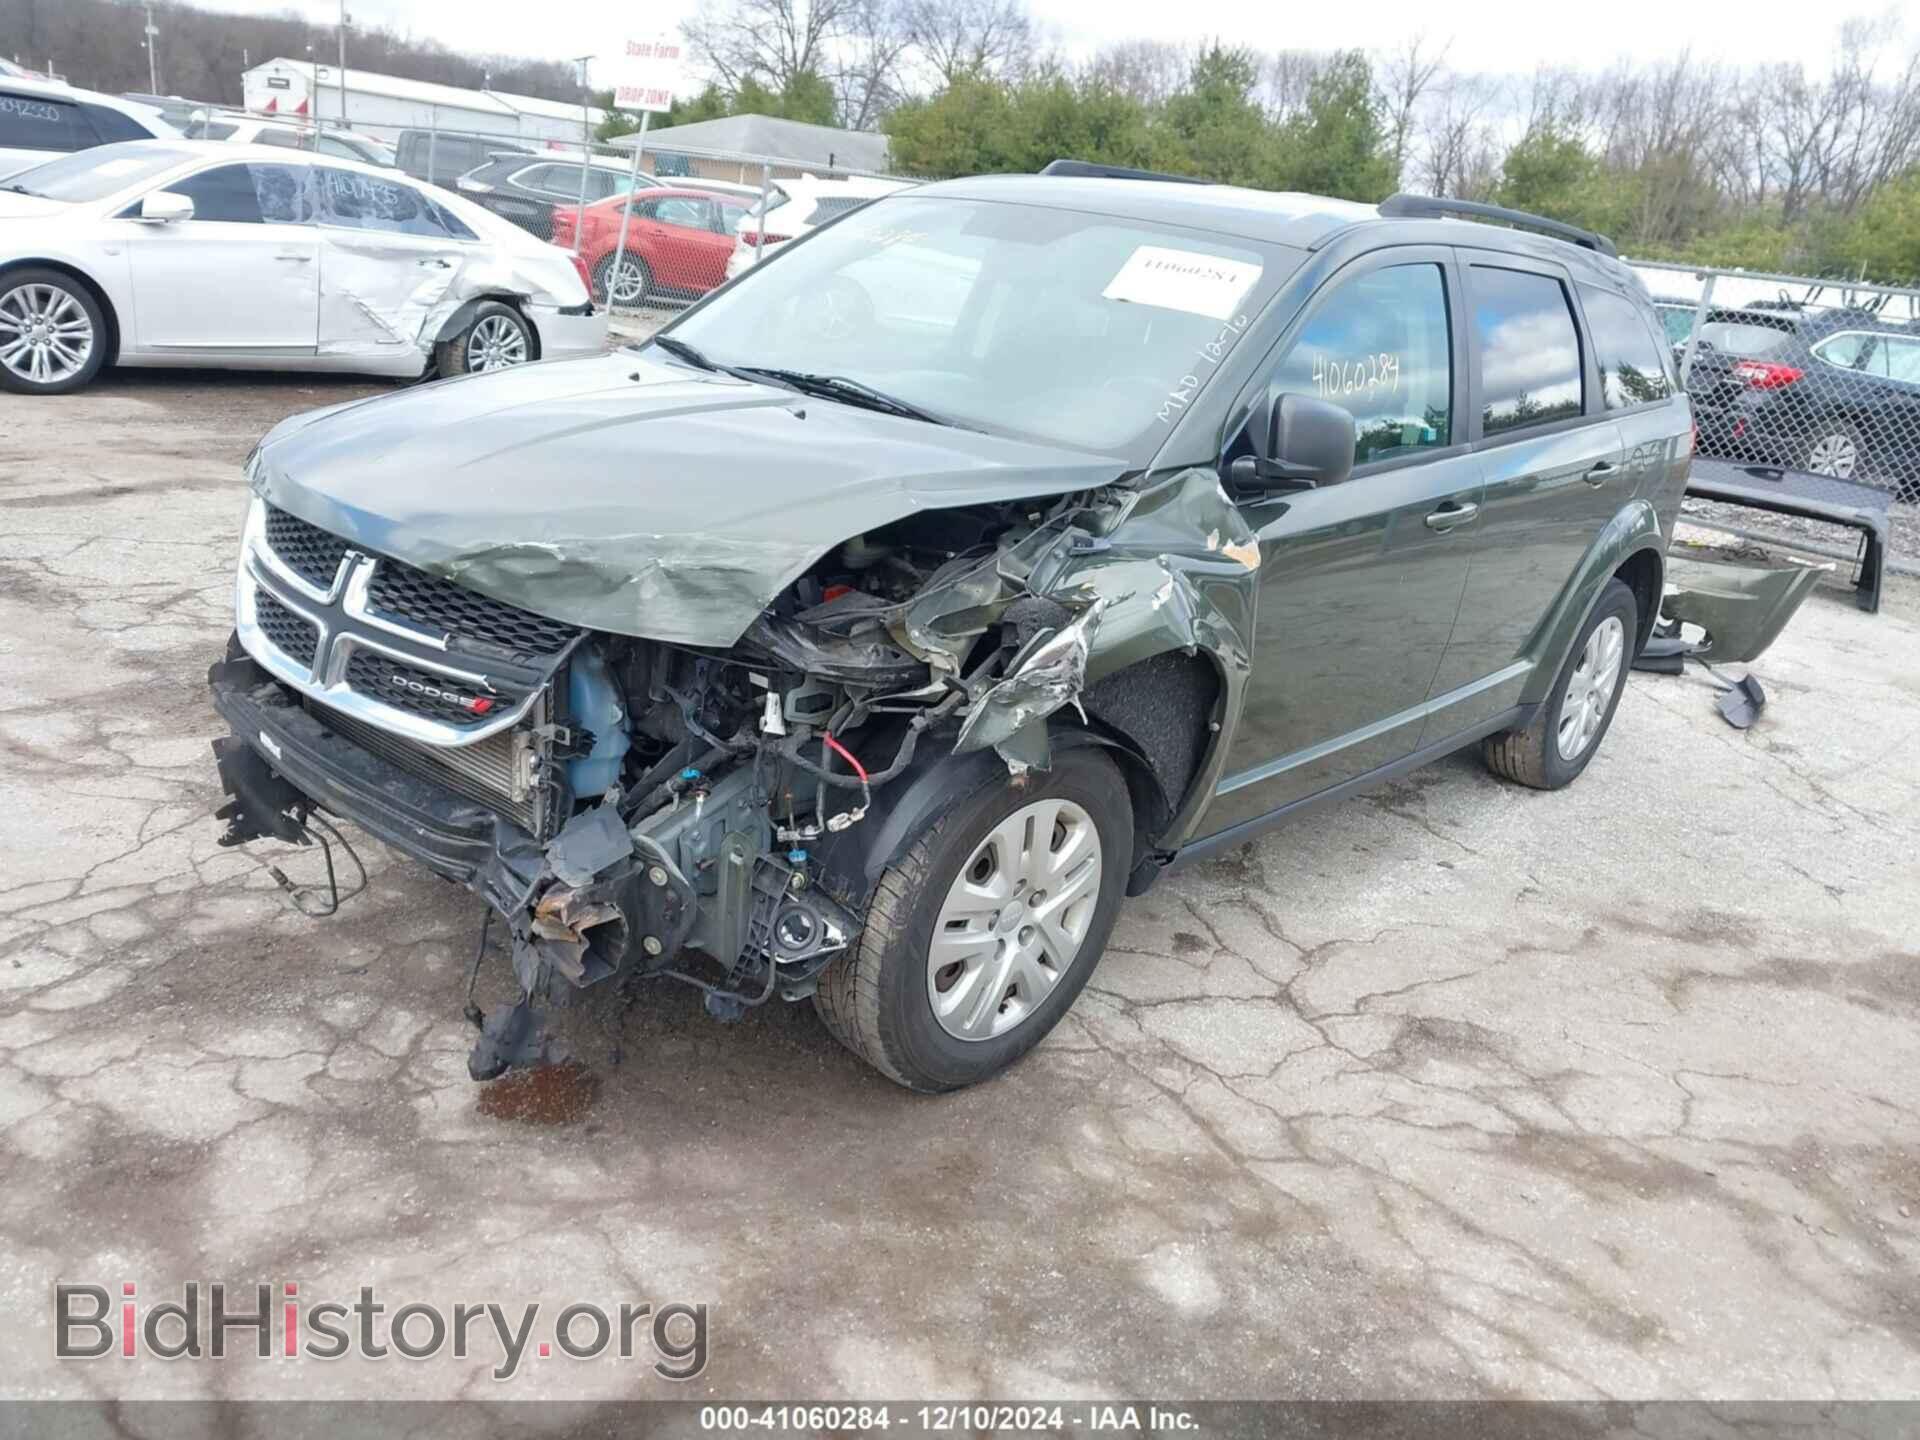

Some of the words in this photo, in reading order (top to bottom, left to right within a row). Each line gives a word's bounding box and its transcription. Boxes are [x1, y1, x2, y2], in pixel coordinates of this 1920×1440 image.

[625, 40, 652, 56] State
[655, 42, 680, 59] Farm
[617, 87, 644, 102] DROP
[645, 89, 670, 105] ZONE
[1312, 352, 1399, 400] 41060284
[1157, 375, 1199, 423] MAD
[392, 675, 476, 707] DODGE
